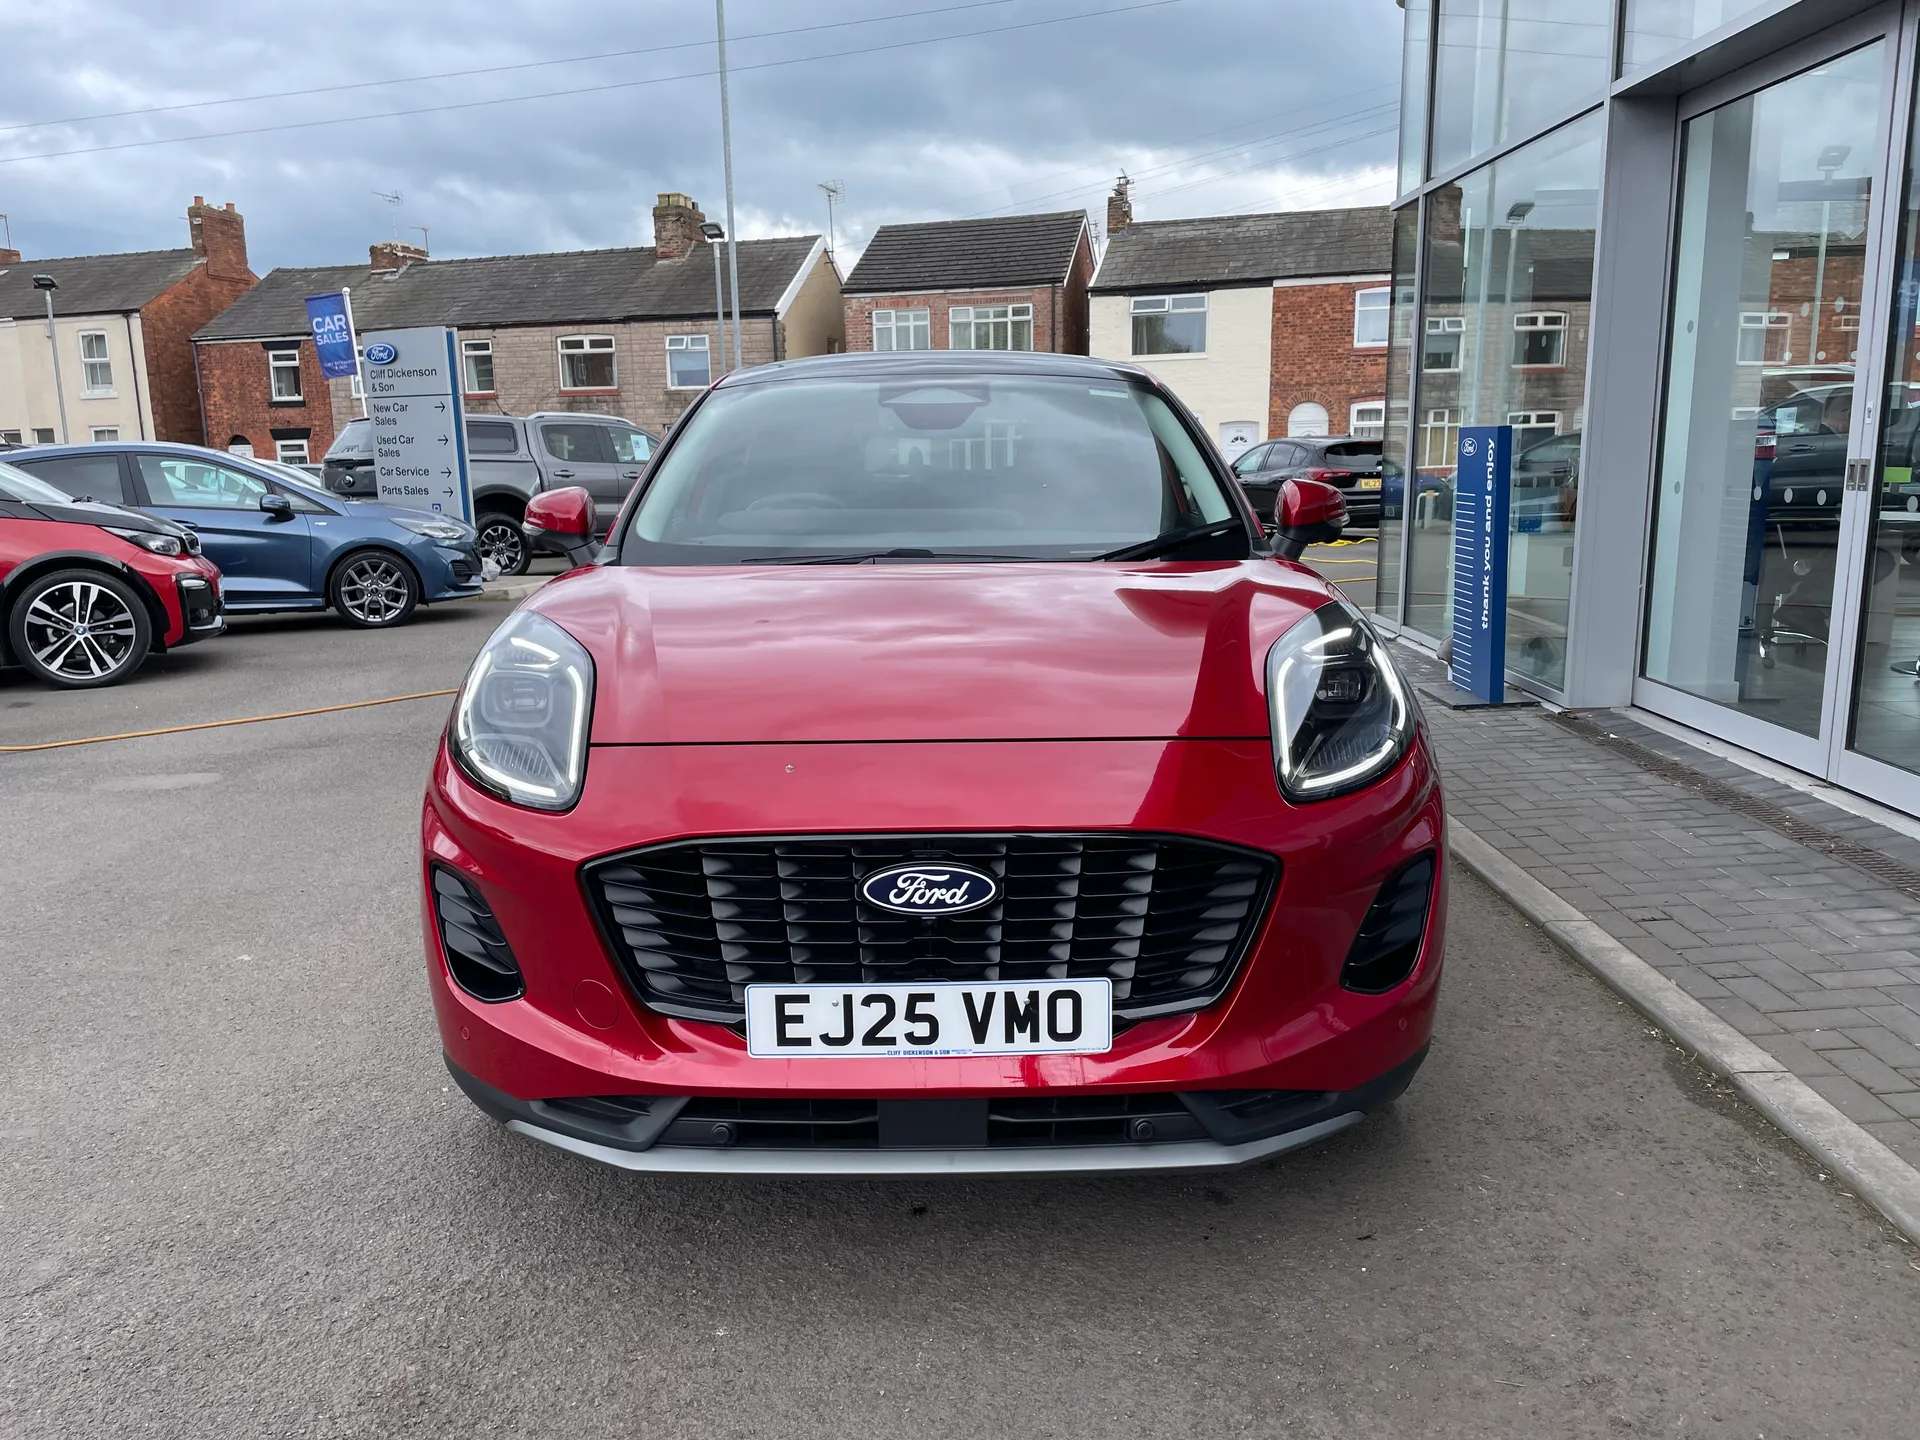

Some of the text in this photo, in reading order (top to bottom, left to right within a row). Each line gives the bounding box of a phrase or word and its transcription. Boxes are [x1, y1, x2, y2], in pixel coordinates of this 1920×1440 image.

[313, 314, 347, 333] CAR
[316, 331, 349, 346] SALES
[370, 368, 437, 379] Cliff Dickenson
[371, 382, 395, 392] & Son
[373, 402, 408, 413] New Car
[375, 416, 397, 426] Sales
[376, 434, 415, 445] Used Car
[378, 448, 401, 457] Sales
[380, 466, 430, 476] Car Service
[382, 485, 429, 495] Parts Sales
[1481, 575, 1490, 630] thank
[1486, 437, 1495, 491] enjoy
[888, 873, 970, 904] Ford
[774, 988, 1083, 1047] EJ25 VMO
